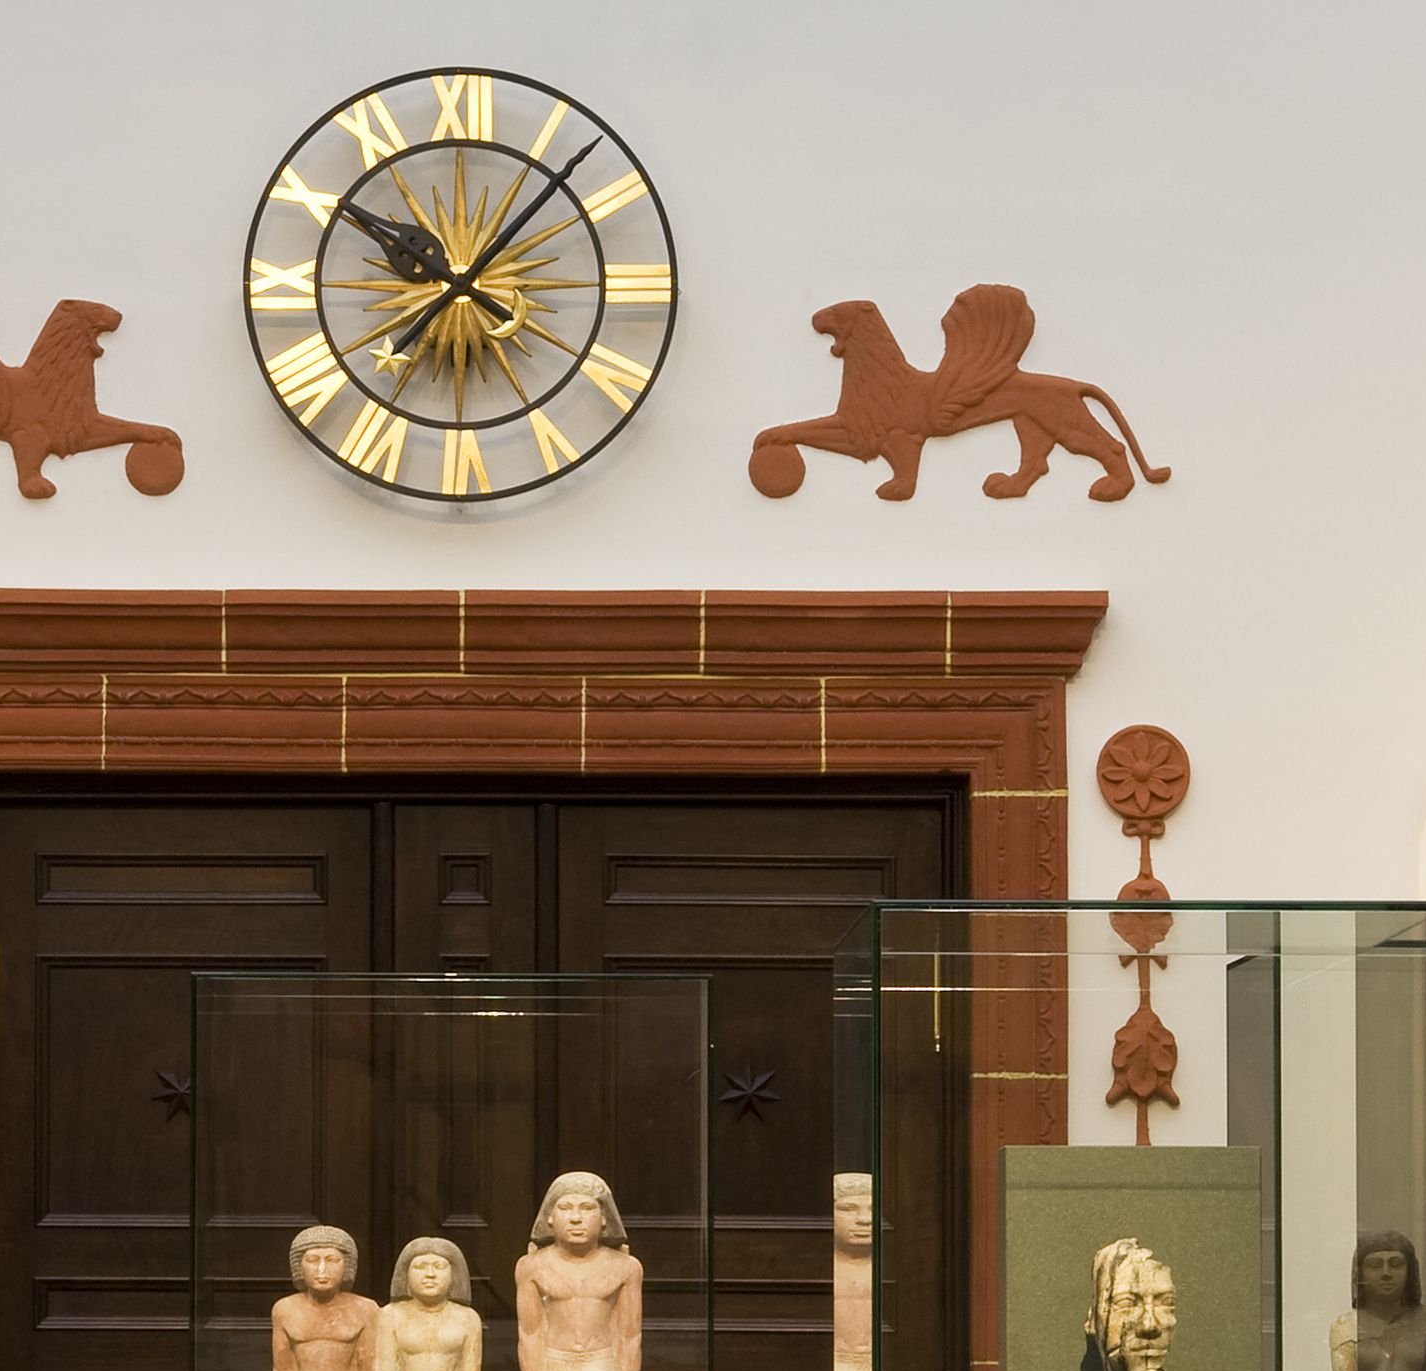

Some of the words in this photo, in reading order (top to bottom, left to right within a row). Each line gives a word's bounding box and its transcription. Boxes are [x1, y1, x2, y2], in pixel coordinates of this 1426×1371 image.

[332, 93, 408, 171] XI
[430, 75, 493, 142] XII
[528, 100, 570, 160] I
[269, 165, 341, 229] X
[582, 170, 649, 223] II
[250, 258, 317, 310] IX
[605, 264, 671, 303] III
[265, 331, 348, 426] VIII
[580, 342, 653, 414] IV
[337, 399, 409, 483] VII
[442, 429, 492, 495] VI
[529, 408, 581, 474] V
